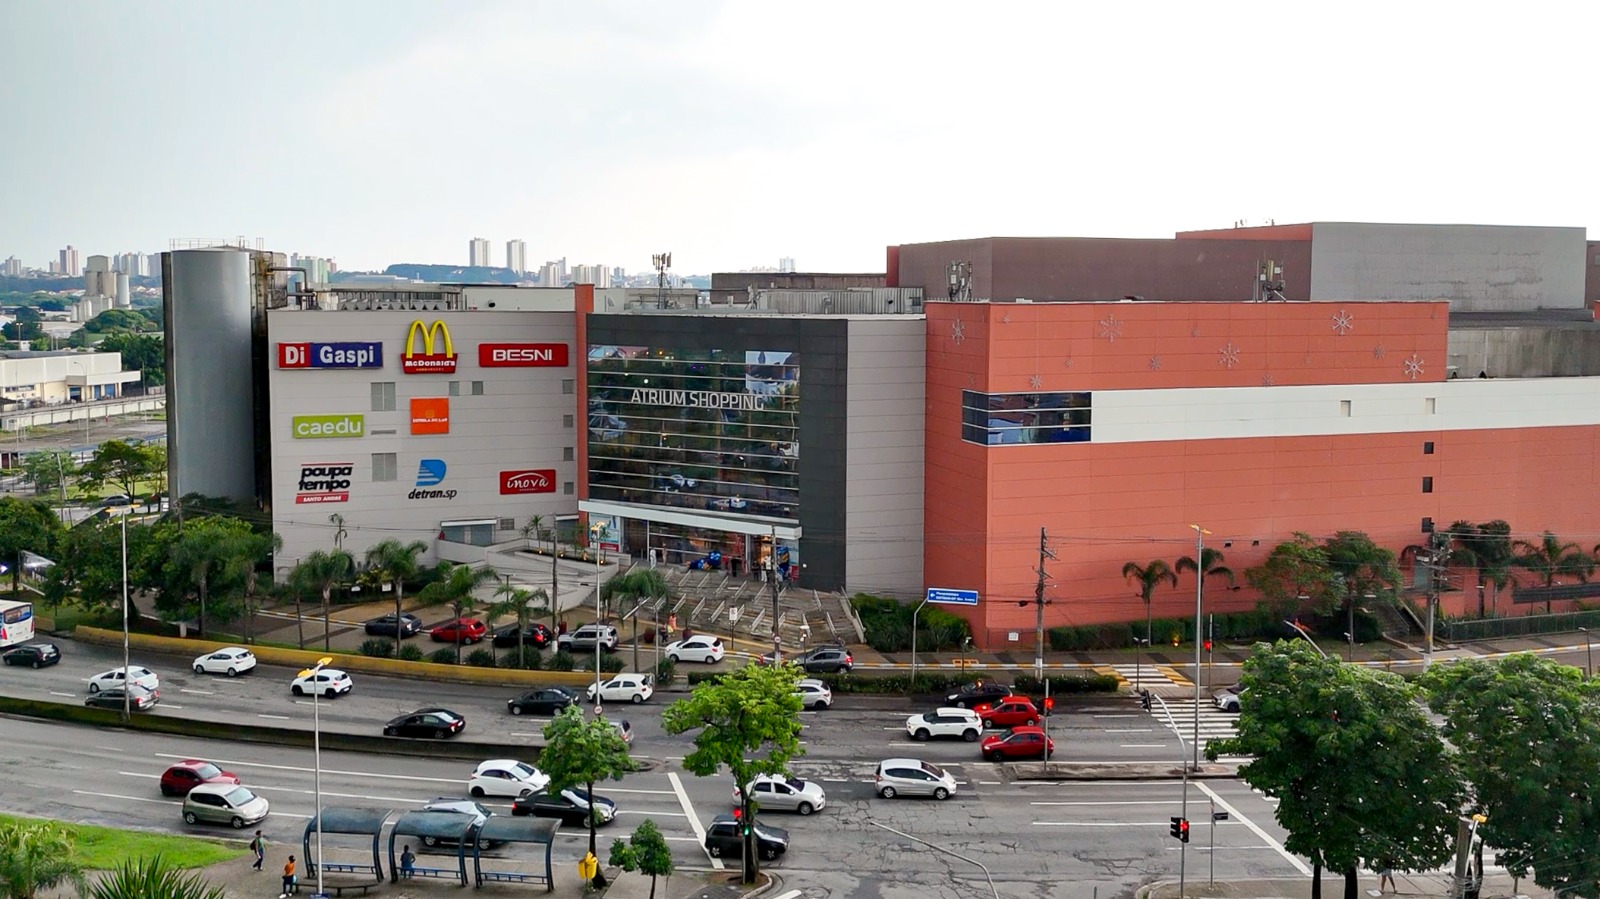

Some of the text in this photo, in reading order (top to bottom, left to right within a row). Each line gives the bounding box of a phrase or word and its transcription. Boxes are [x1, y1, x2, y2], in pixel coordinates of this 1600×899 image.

[285, 345, 374, 367] Di Gaspi
[493, 349, 552, 361] BESNI
[630, 389, 764, 411] ATRIUM SHOPPING
[297, 417, 361, 435] caedu
[300, 466, 353, 480] poupa
[298, 479, 351, 492] tempo
[507, 478, 549, 489] inova
[408, 488, 458, 500] detran.sp
